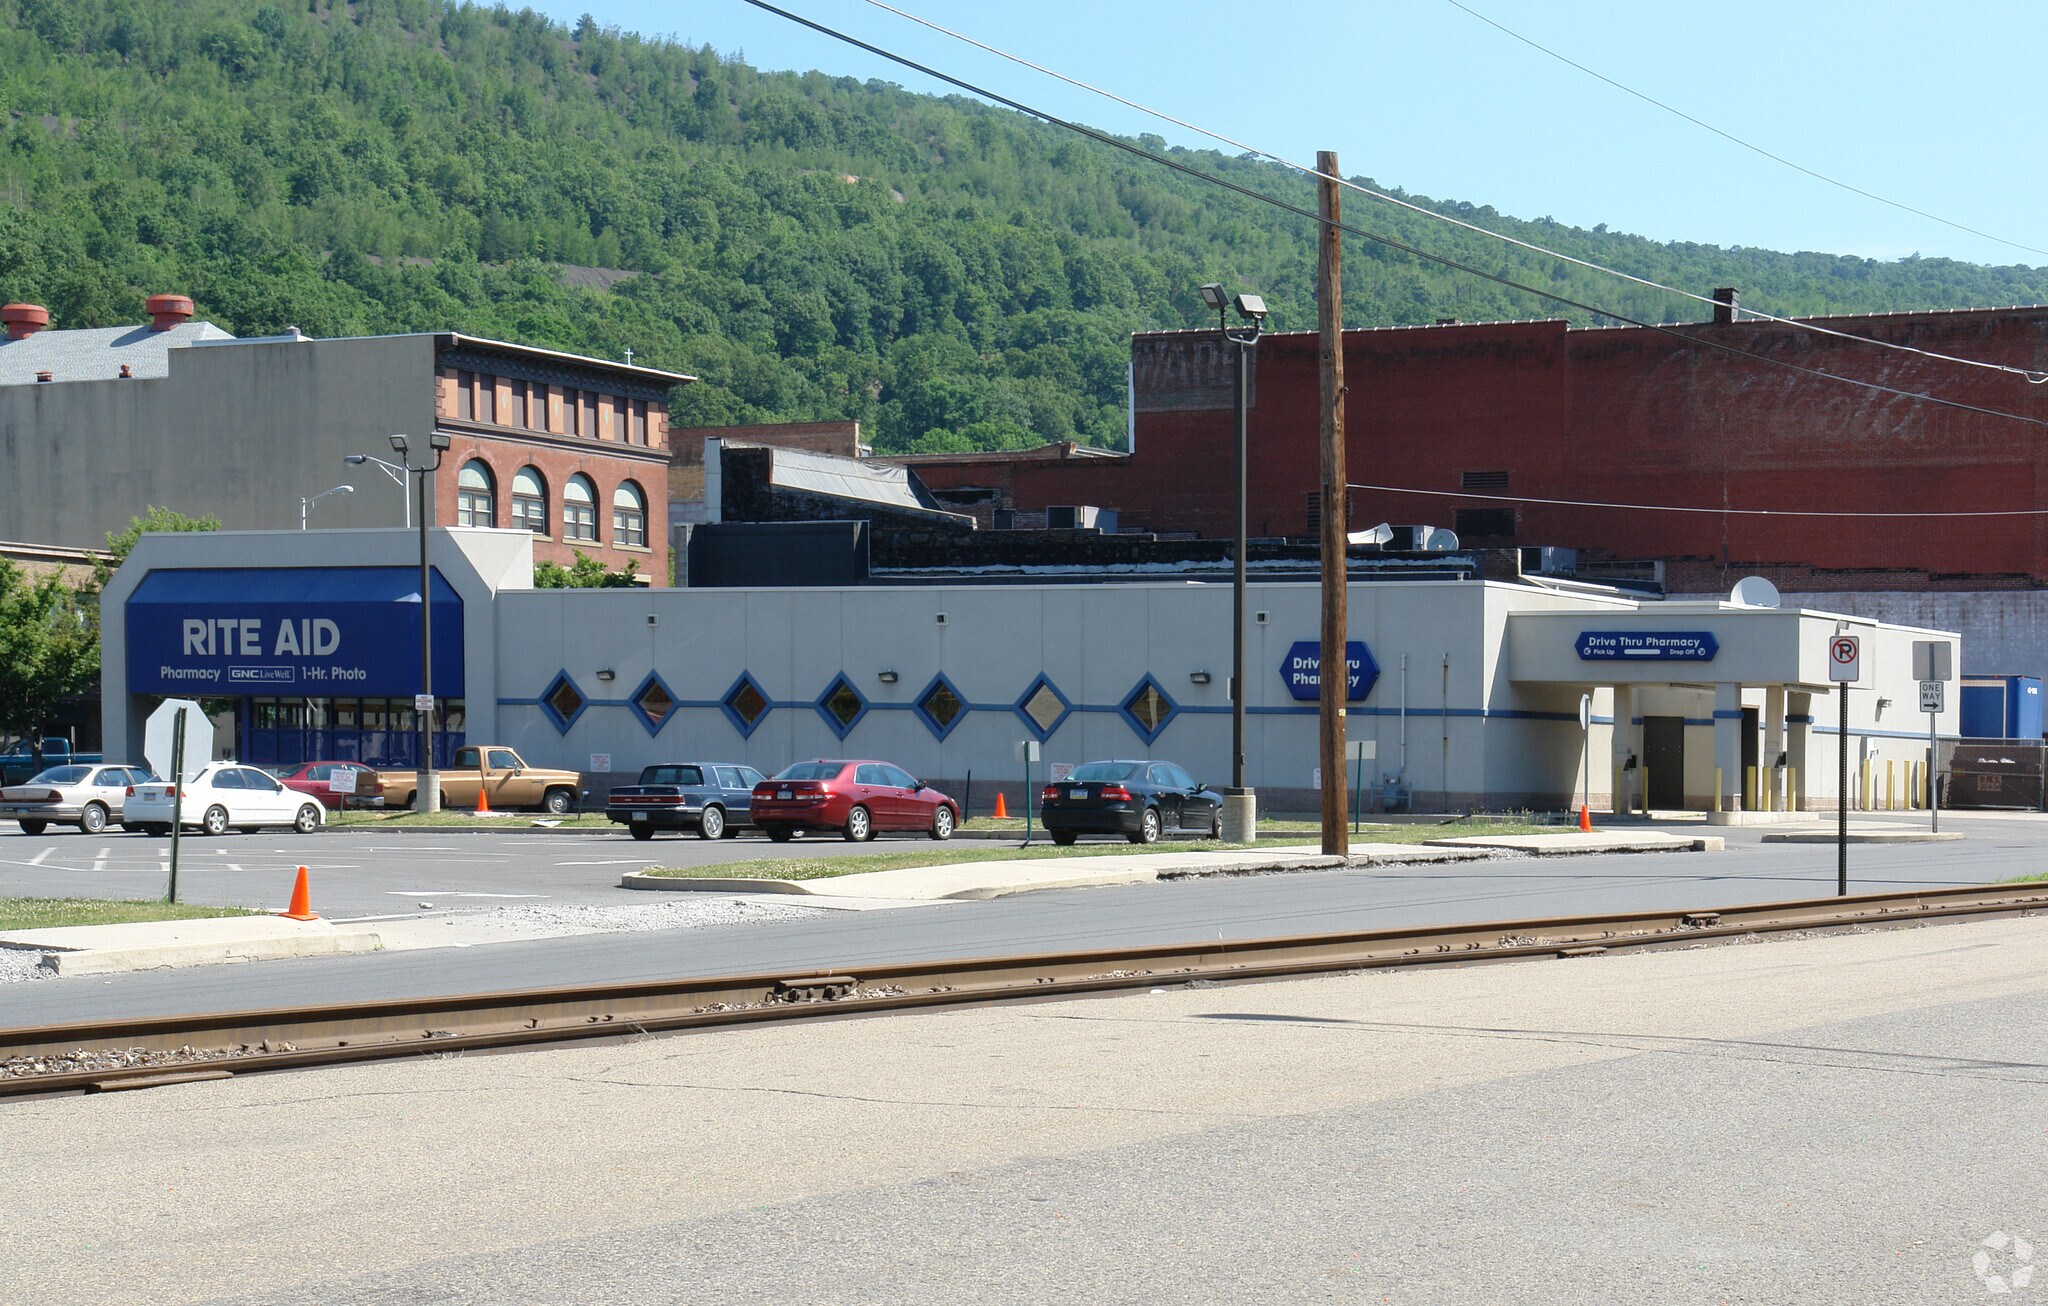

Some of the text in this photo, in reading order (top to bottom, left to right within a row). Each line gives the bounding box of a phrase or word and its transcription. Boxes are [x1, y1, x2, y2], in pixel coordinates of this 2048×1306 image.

[183, 618, 341, 656] RITE AID
[1589, 637, 1700, 648] Drive Thru Pharmacy
[1293, 657, 1320, 669] Driv
[160, 666, 221, 682] Pharmacy
[231, 669, 260, 678] GNC
[302, 666, 367, 680] 1-Hr. Photo
[1922, 684, 1940, 692] ONE
[1922, 692, 1941, 700] WAY
